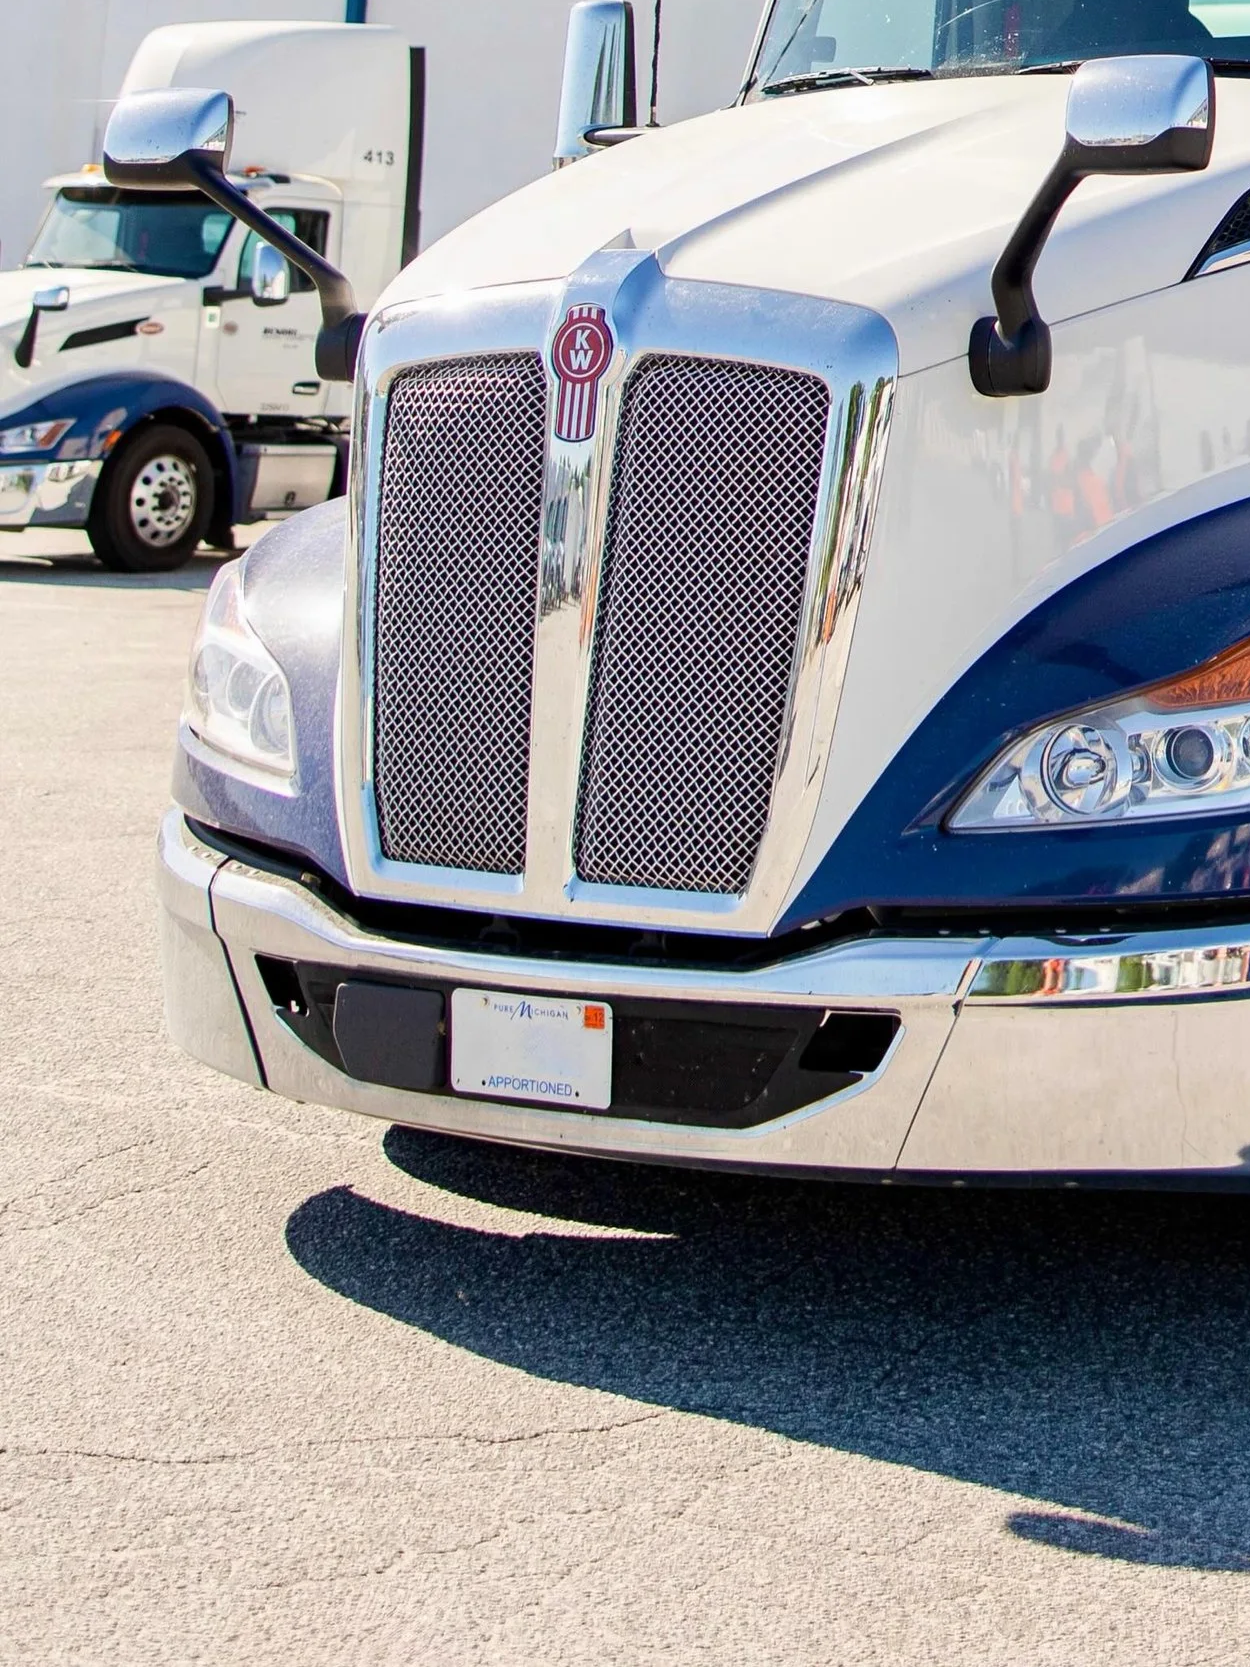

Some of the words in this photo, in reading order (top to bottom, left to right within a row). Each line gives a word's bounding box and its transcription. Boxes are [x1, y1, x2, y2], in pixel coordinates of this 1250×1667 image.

[363, 150, 395, 167] 413
[494, 1003, 514, 1014] PURE
[488, 1075, 574, 1098] APPORTIONED
